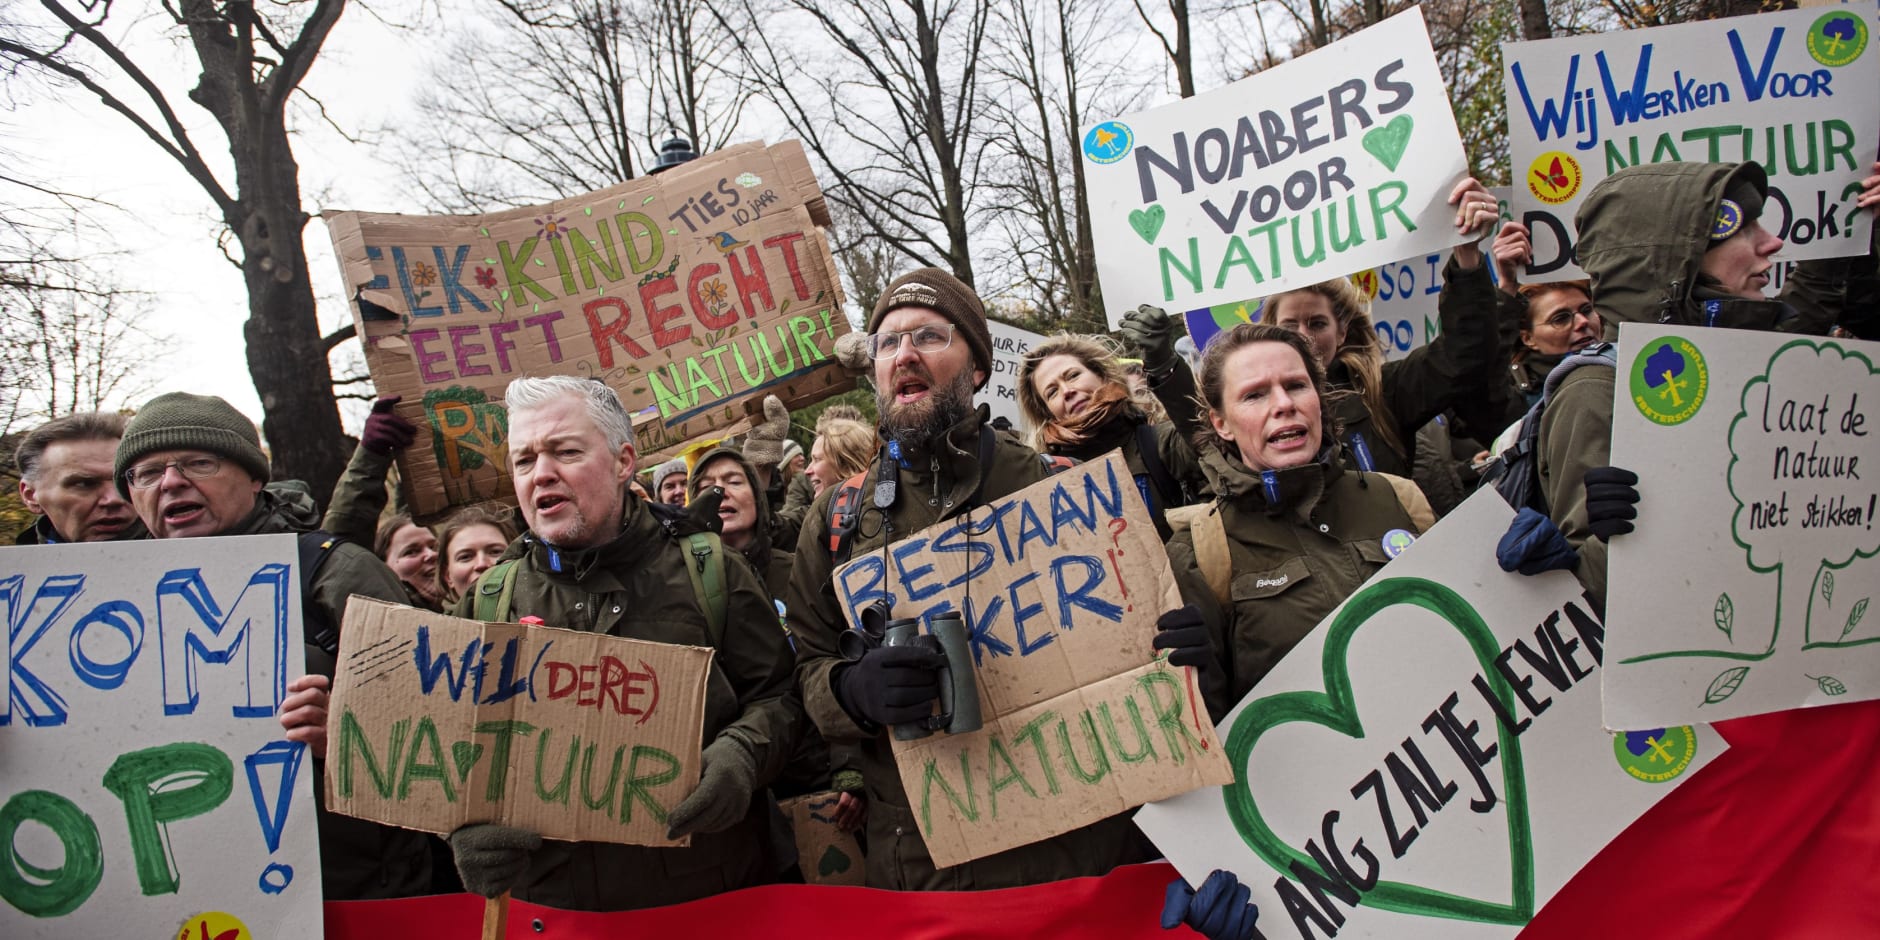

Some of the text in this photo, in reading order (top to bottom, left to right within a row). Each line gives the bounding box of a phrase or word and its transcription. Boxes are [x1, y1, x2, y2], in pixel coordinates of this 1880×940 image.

[1133, 58, 1415, 203] NOABERS
[1511, 54, 1598, 150] Wij
[1604, 119, 1859, 178] NATUUR
[731, 208, 750, 227] 10
[1158, 180, 1417, 302] NATUUR
[1200, 156, 1355, 234] VOOR
[582, 231, 814, 369] RECHT
[646, 308, 836, 419] NATUUR!
[1635, 341, 1707, 423] #BETERSCHAPNATUUR
[1762, 384, 1868, 437] laat de
[1750, 491, 1789, 530] niet
[0, 563, 291, 728] KOM
[337, 703, 683, 825] NATUUR
[923, 664, 1209, 838] NATUUR!
[1252, 809, 1380, 940] ANG
[1350, 736, 1458, 861] ZAL
[1421, 691, 1499, 814] JE
